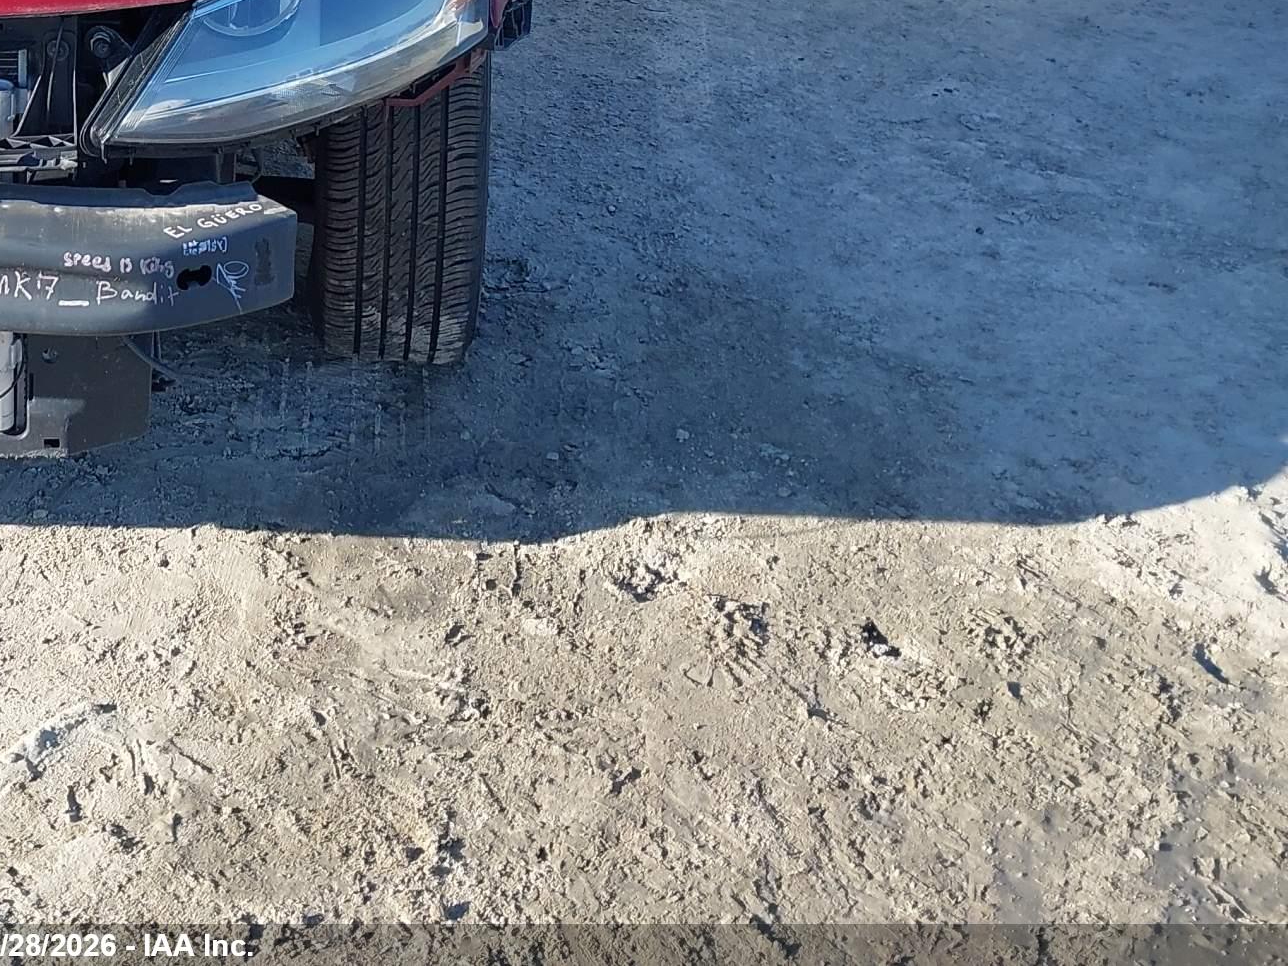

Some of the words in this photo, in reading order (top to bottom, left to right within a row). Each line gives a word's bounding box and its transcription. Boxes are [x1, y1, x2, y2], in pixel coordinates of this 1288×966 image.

[163, 225, 192, 238] EL
[197, 204, 262, 228] GÜERO
[95, 280, 180, 307] Bandit
